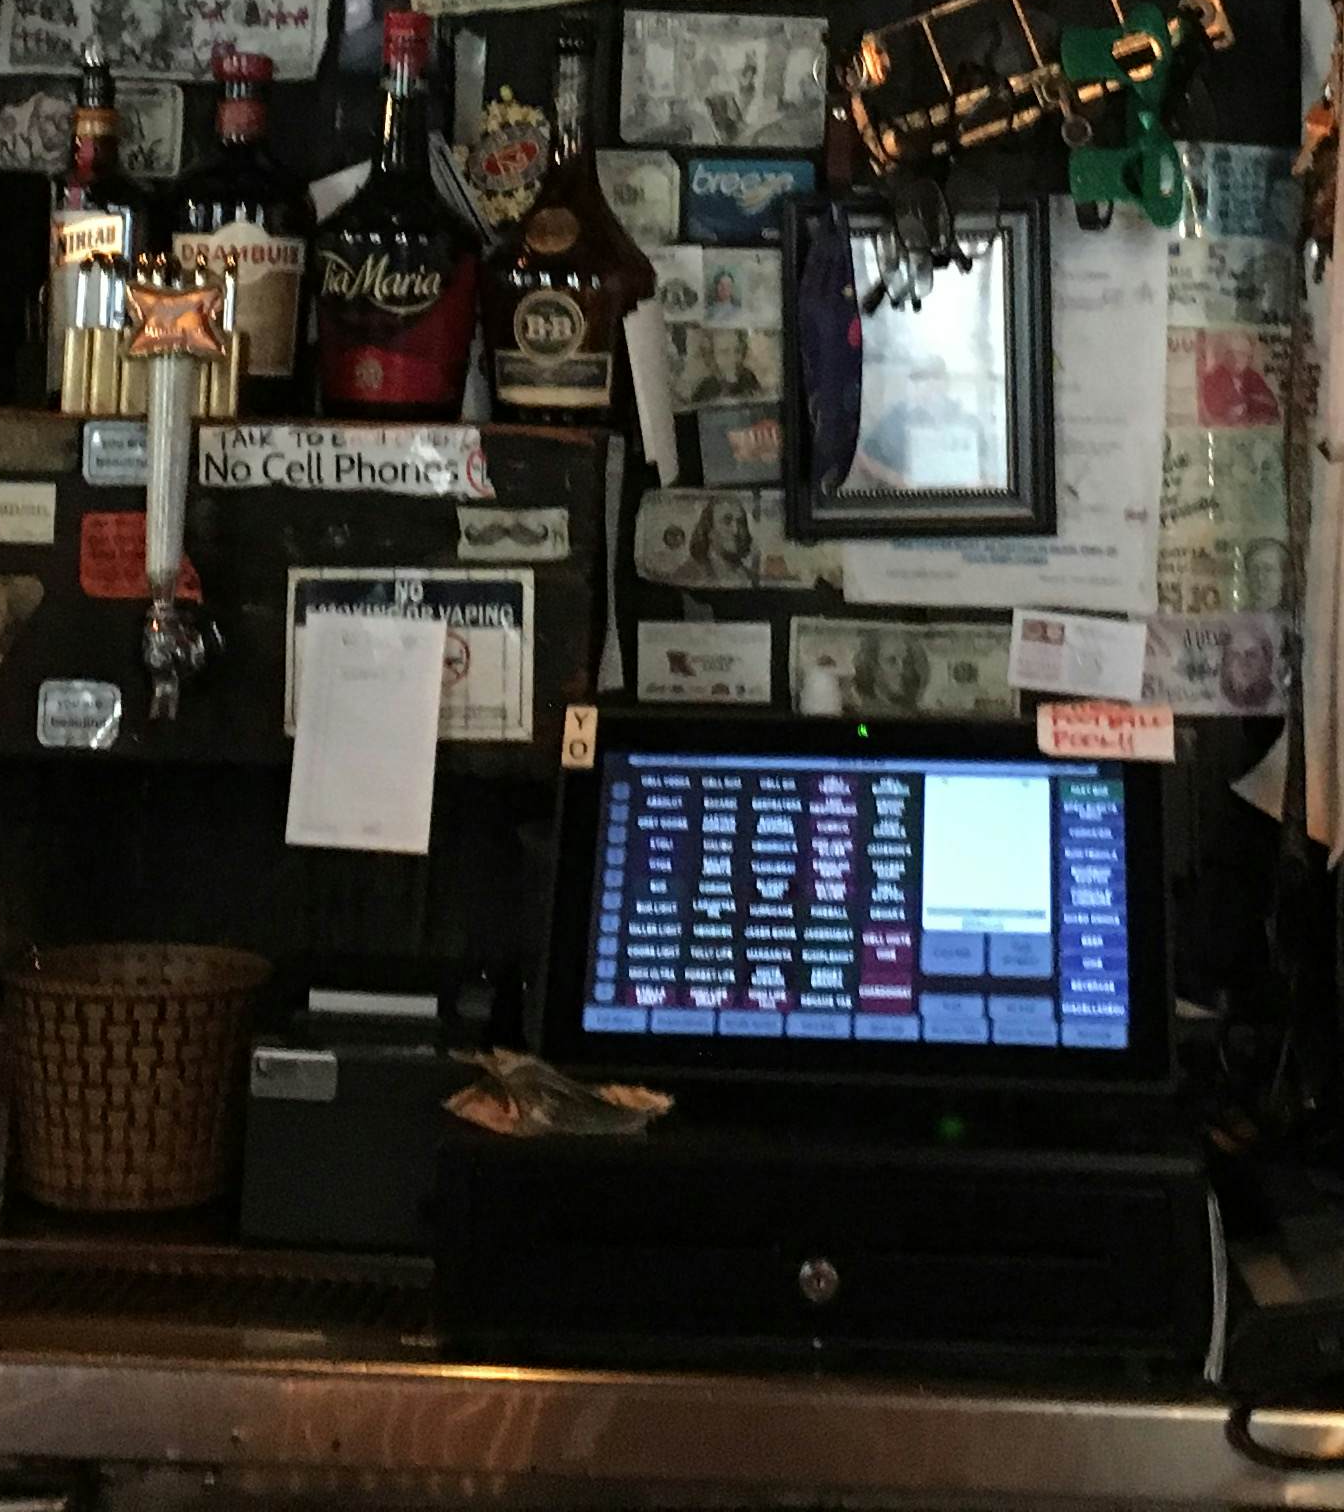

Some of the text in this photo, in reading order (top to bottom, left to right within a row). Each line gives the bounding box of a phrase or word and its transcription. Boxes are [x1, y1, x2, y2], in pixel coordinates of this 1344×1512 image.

[181, 243, 300, 265] DRAMBUIE
[320, 250, 441, 300] Tia Maria
[288, 430, 324, 448] TO
[205, 449, 459, 485] No Cell Phones
[394, 579, 425, 604] NO
[437, 602, 515, 628] VAPING
[573, 710, 589, 730] Y
[569, 739, 588, 759] O
